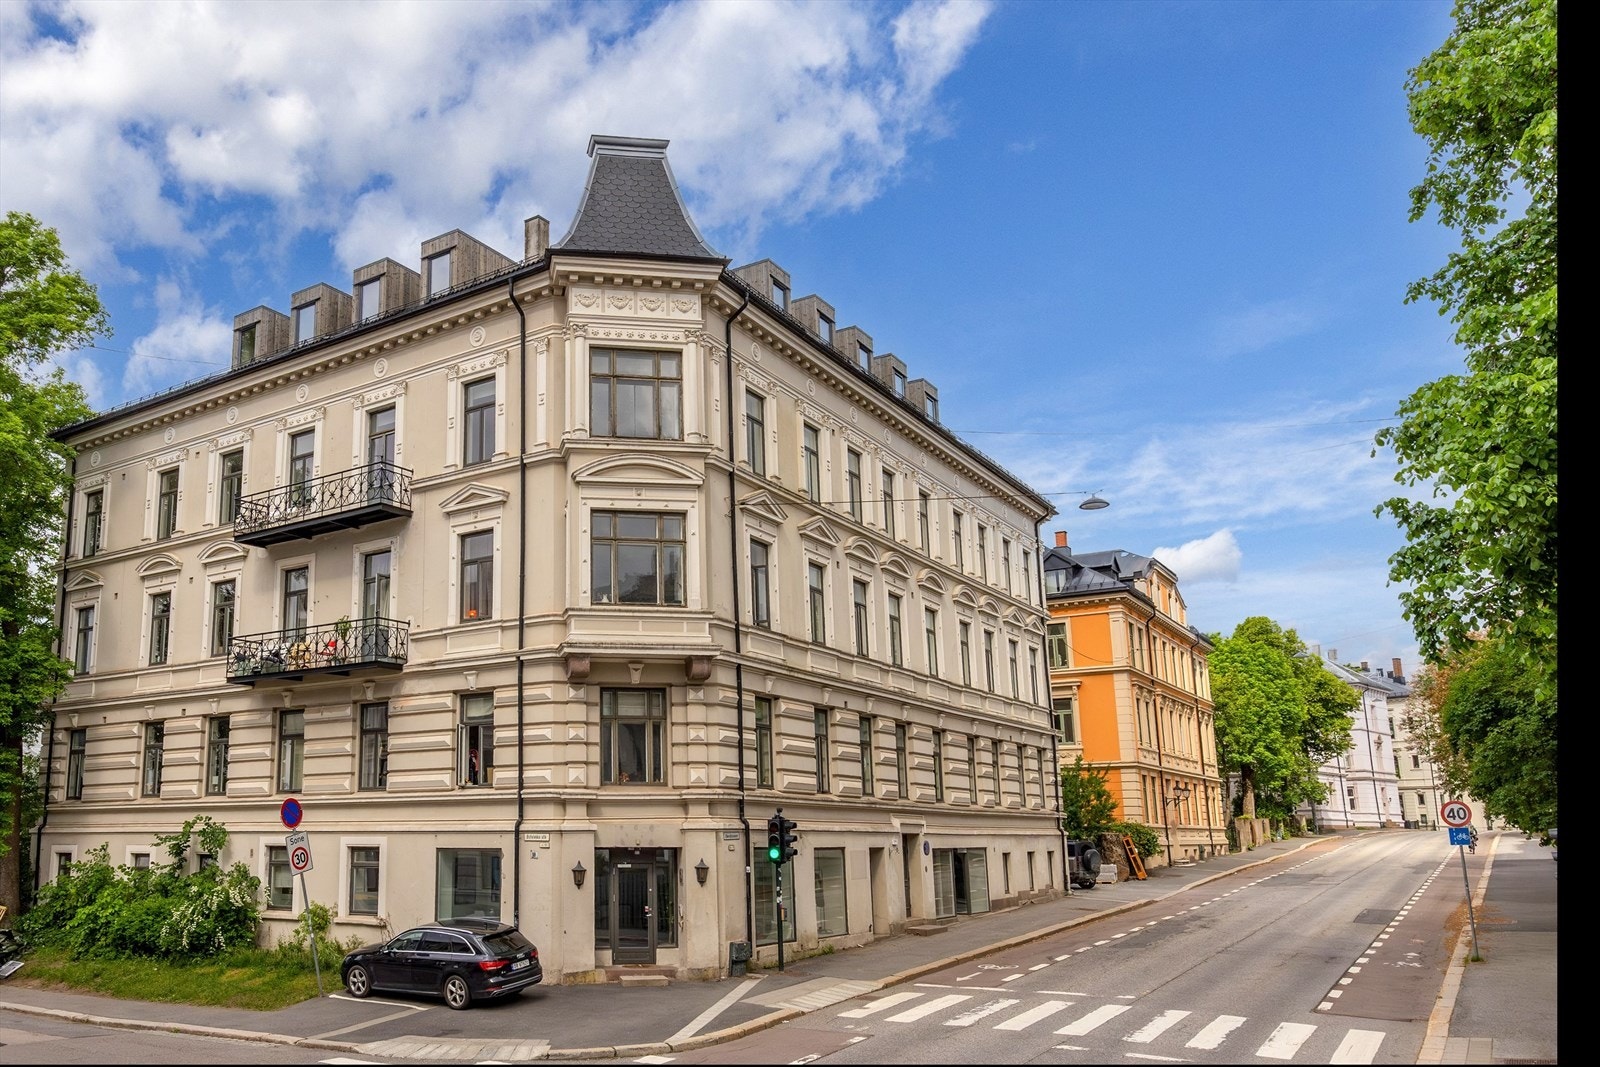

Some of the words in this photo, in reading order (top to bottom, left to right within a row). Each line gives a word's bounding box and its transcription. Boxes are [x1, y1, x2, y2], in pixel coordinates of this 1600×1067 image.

[1446, 807, 1467, 820] 40
[289, 835, 305, 846] Sone
[294, 852, 306, 865] 30
